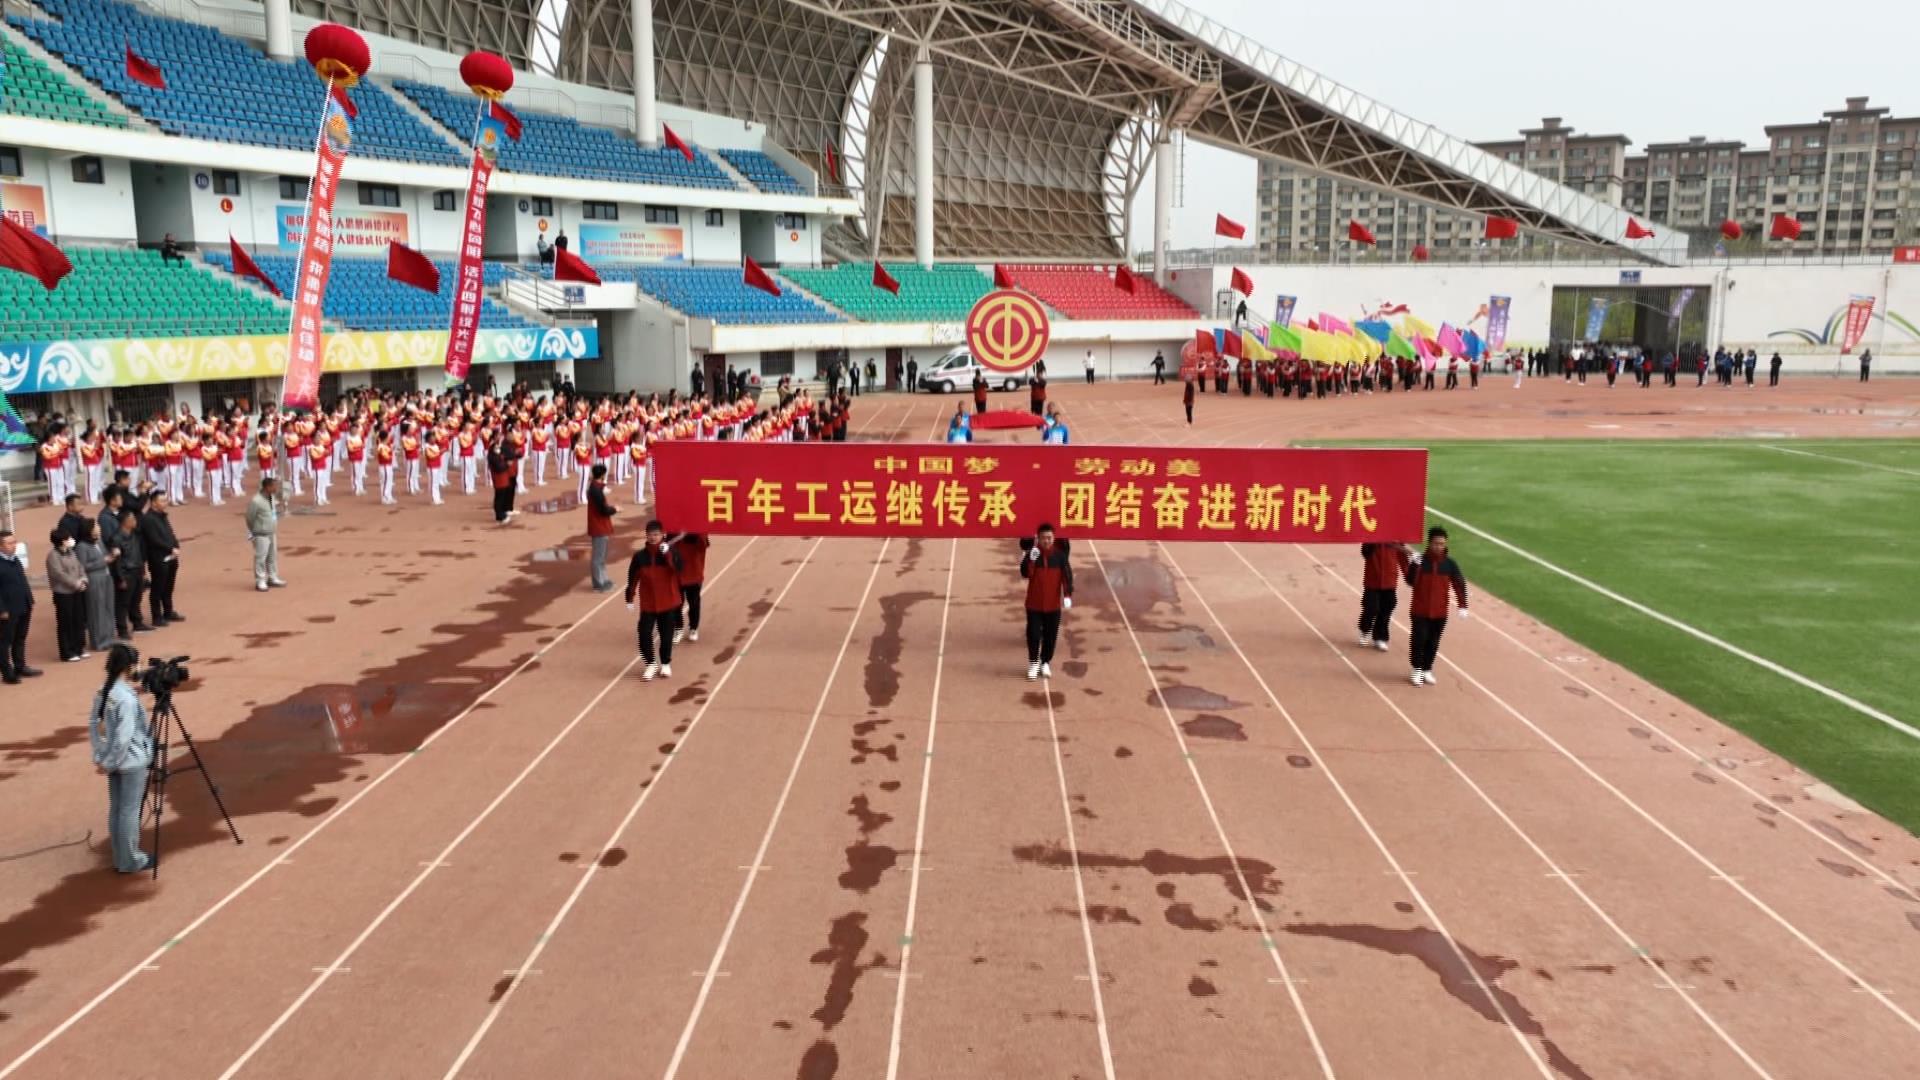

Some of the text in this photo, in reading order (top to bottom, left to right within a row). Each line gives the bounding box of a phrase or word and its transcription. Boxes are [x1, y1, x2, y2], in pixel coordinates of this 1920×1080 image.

[700, 478, 1378, 532] 百年工运继传承 团结奋进新时代
